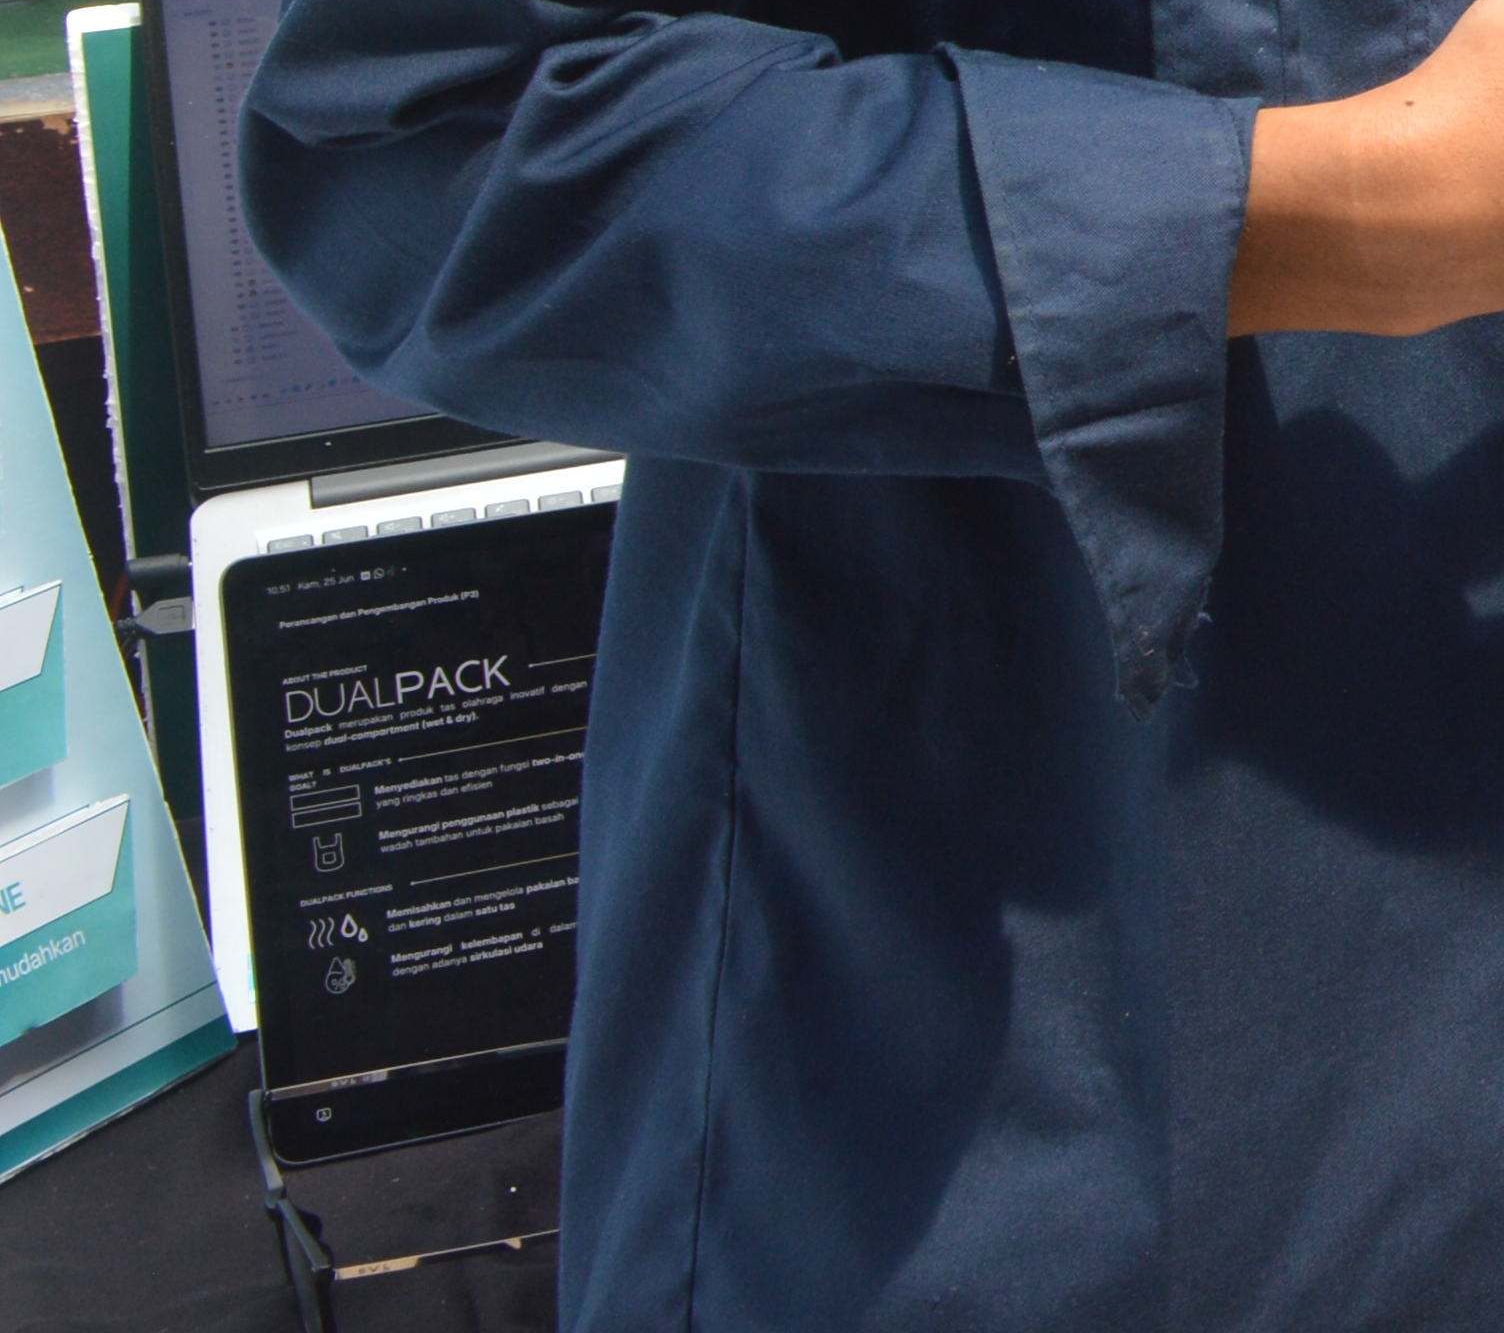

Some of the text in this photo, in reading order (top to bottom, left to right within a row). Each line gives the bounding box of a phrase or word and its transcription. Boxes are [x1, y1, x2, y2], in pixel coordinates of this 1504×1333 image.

[339, 608, 357, 621] dan
[427, 592, 460, 605] Produk
[282, 664, 368, 686] ABOUT THE PRODUCT
[285, 655, 511, 723] DUALPACK
[284, 680, 587, 739] Dualpack merupakan produk tas olahraga inovatif dengan
[285, 739, 322, 753] konsep
[323, 721, 420, 746] dual-compartment
[421, 716, 445, 729] (wet
[446, 715, 454, 724] &
[288, 770, 315, 782] WHAT
[322, 768, 332, 776] IS
[289, 780, 317, 792] GOAL?
[374, 775, 443, 795] Menyediakan
[444, 774, 459, 783] tas
[462, 766, 498, 781] dengan
[500, 761, 530, 773] fungsi
[376, 780, 493, 810] yang ringkas dan efisien
[379, 797, 579, 840] Mengurangi penggunaan plastik sebagai
[380, 812, 565, 853] wadah tambahan untuk pakaian basah
[300, 884, 394, 908] DUALPACK FUNCTIONS
[386, 900, 452, 919] Memisahkan
[453, 896, 472, 907] dan
[474, 886, 525, 901] mengelola
[526, 879, 566, 894] pakaian
[388, 902, 516, 933] dan kering dalam satu tas
[391, 944, 453, 963] Mengurangi
[461, 931, 524, 950] kelembapan
[531, 926, 541, 937] di
[392, 941, 544, 977] dengan adanya sirkulasi udara
